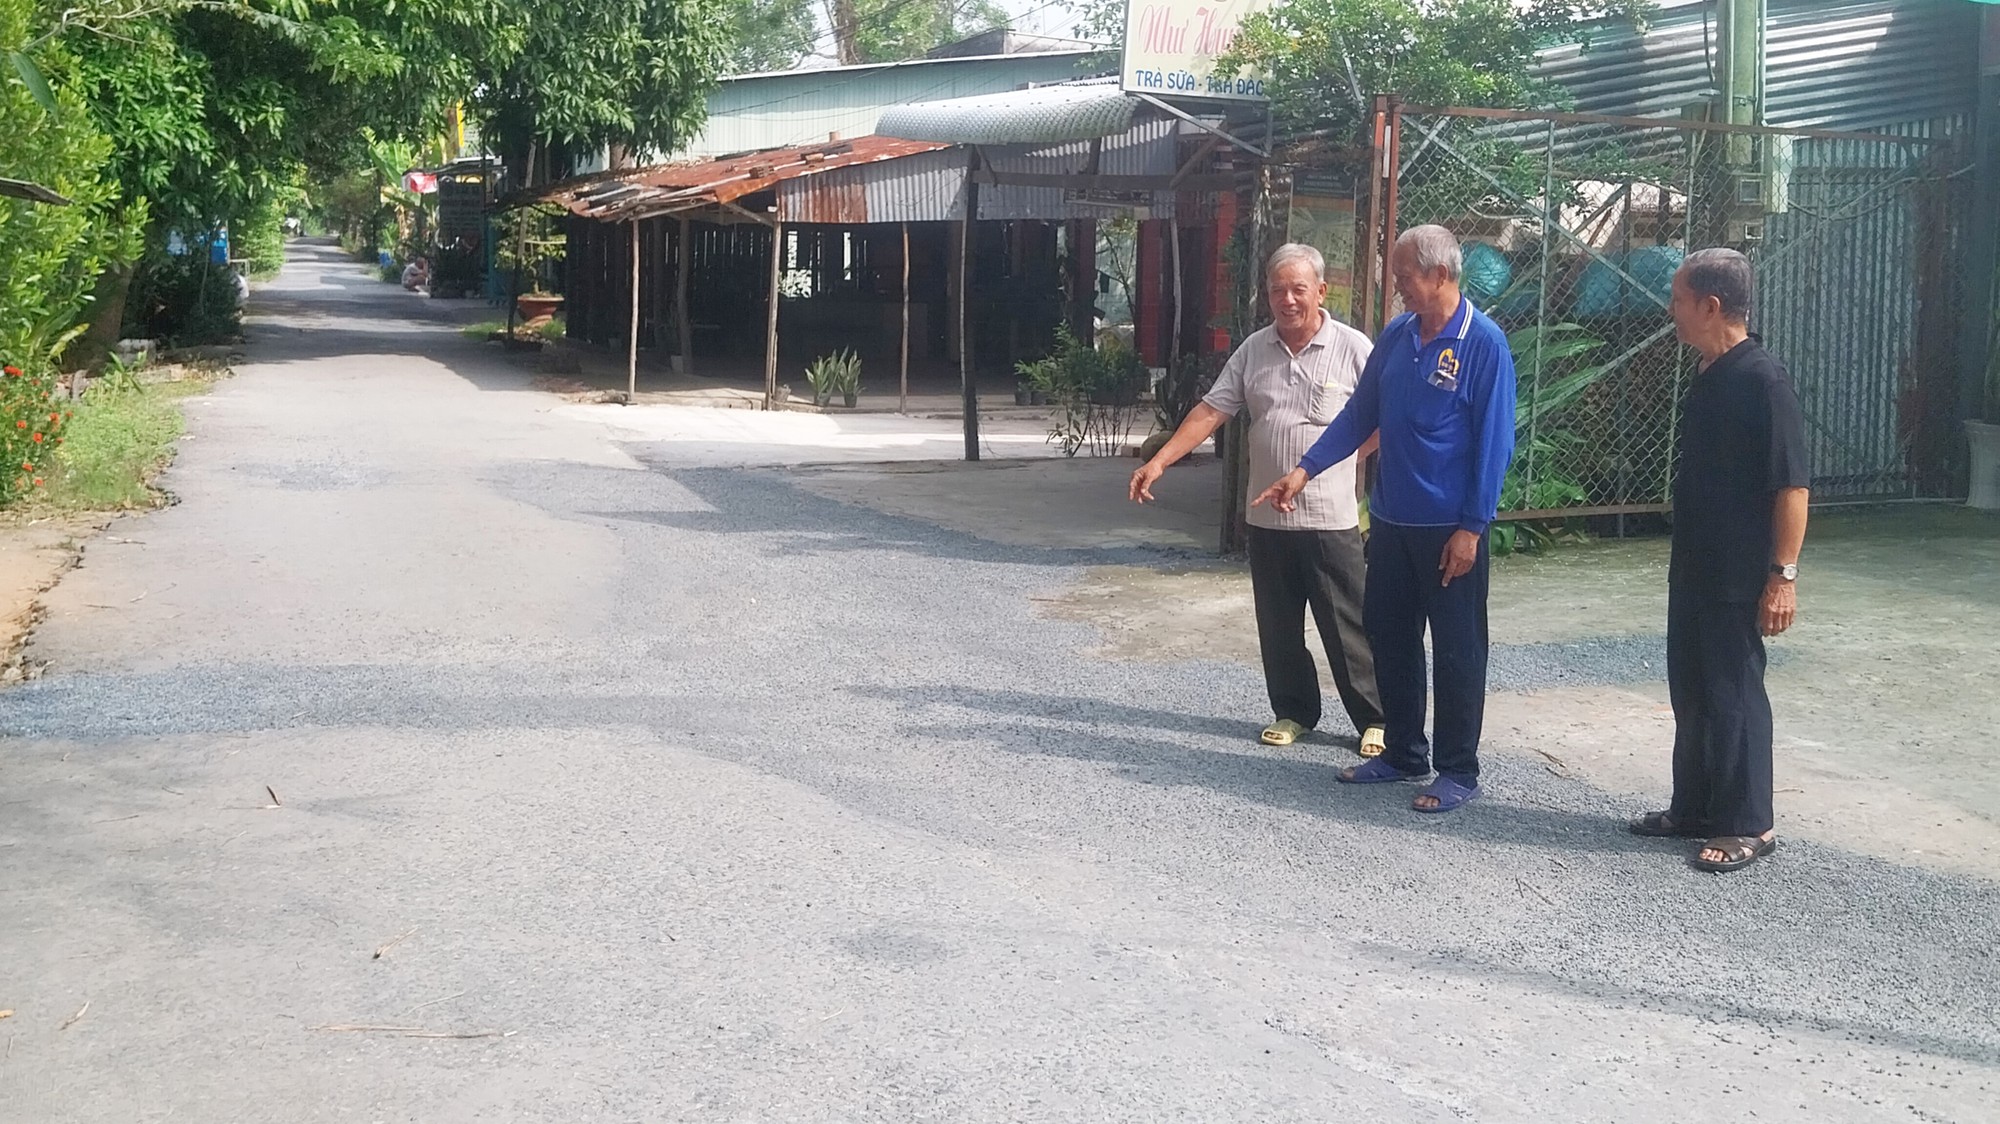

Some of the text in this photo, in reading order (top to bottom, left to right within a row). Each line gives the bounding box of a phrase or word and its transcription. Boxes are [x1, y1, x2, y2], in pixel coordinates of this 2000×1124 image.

[1139, 4, 1189, 54] Như
[1136, 67, 1163, 88] TRÀ
[1167, 69, 1195, 91] SỮA
